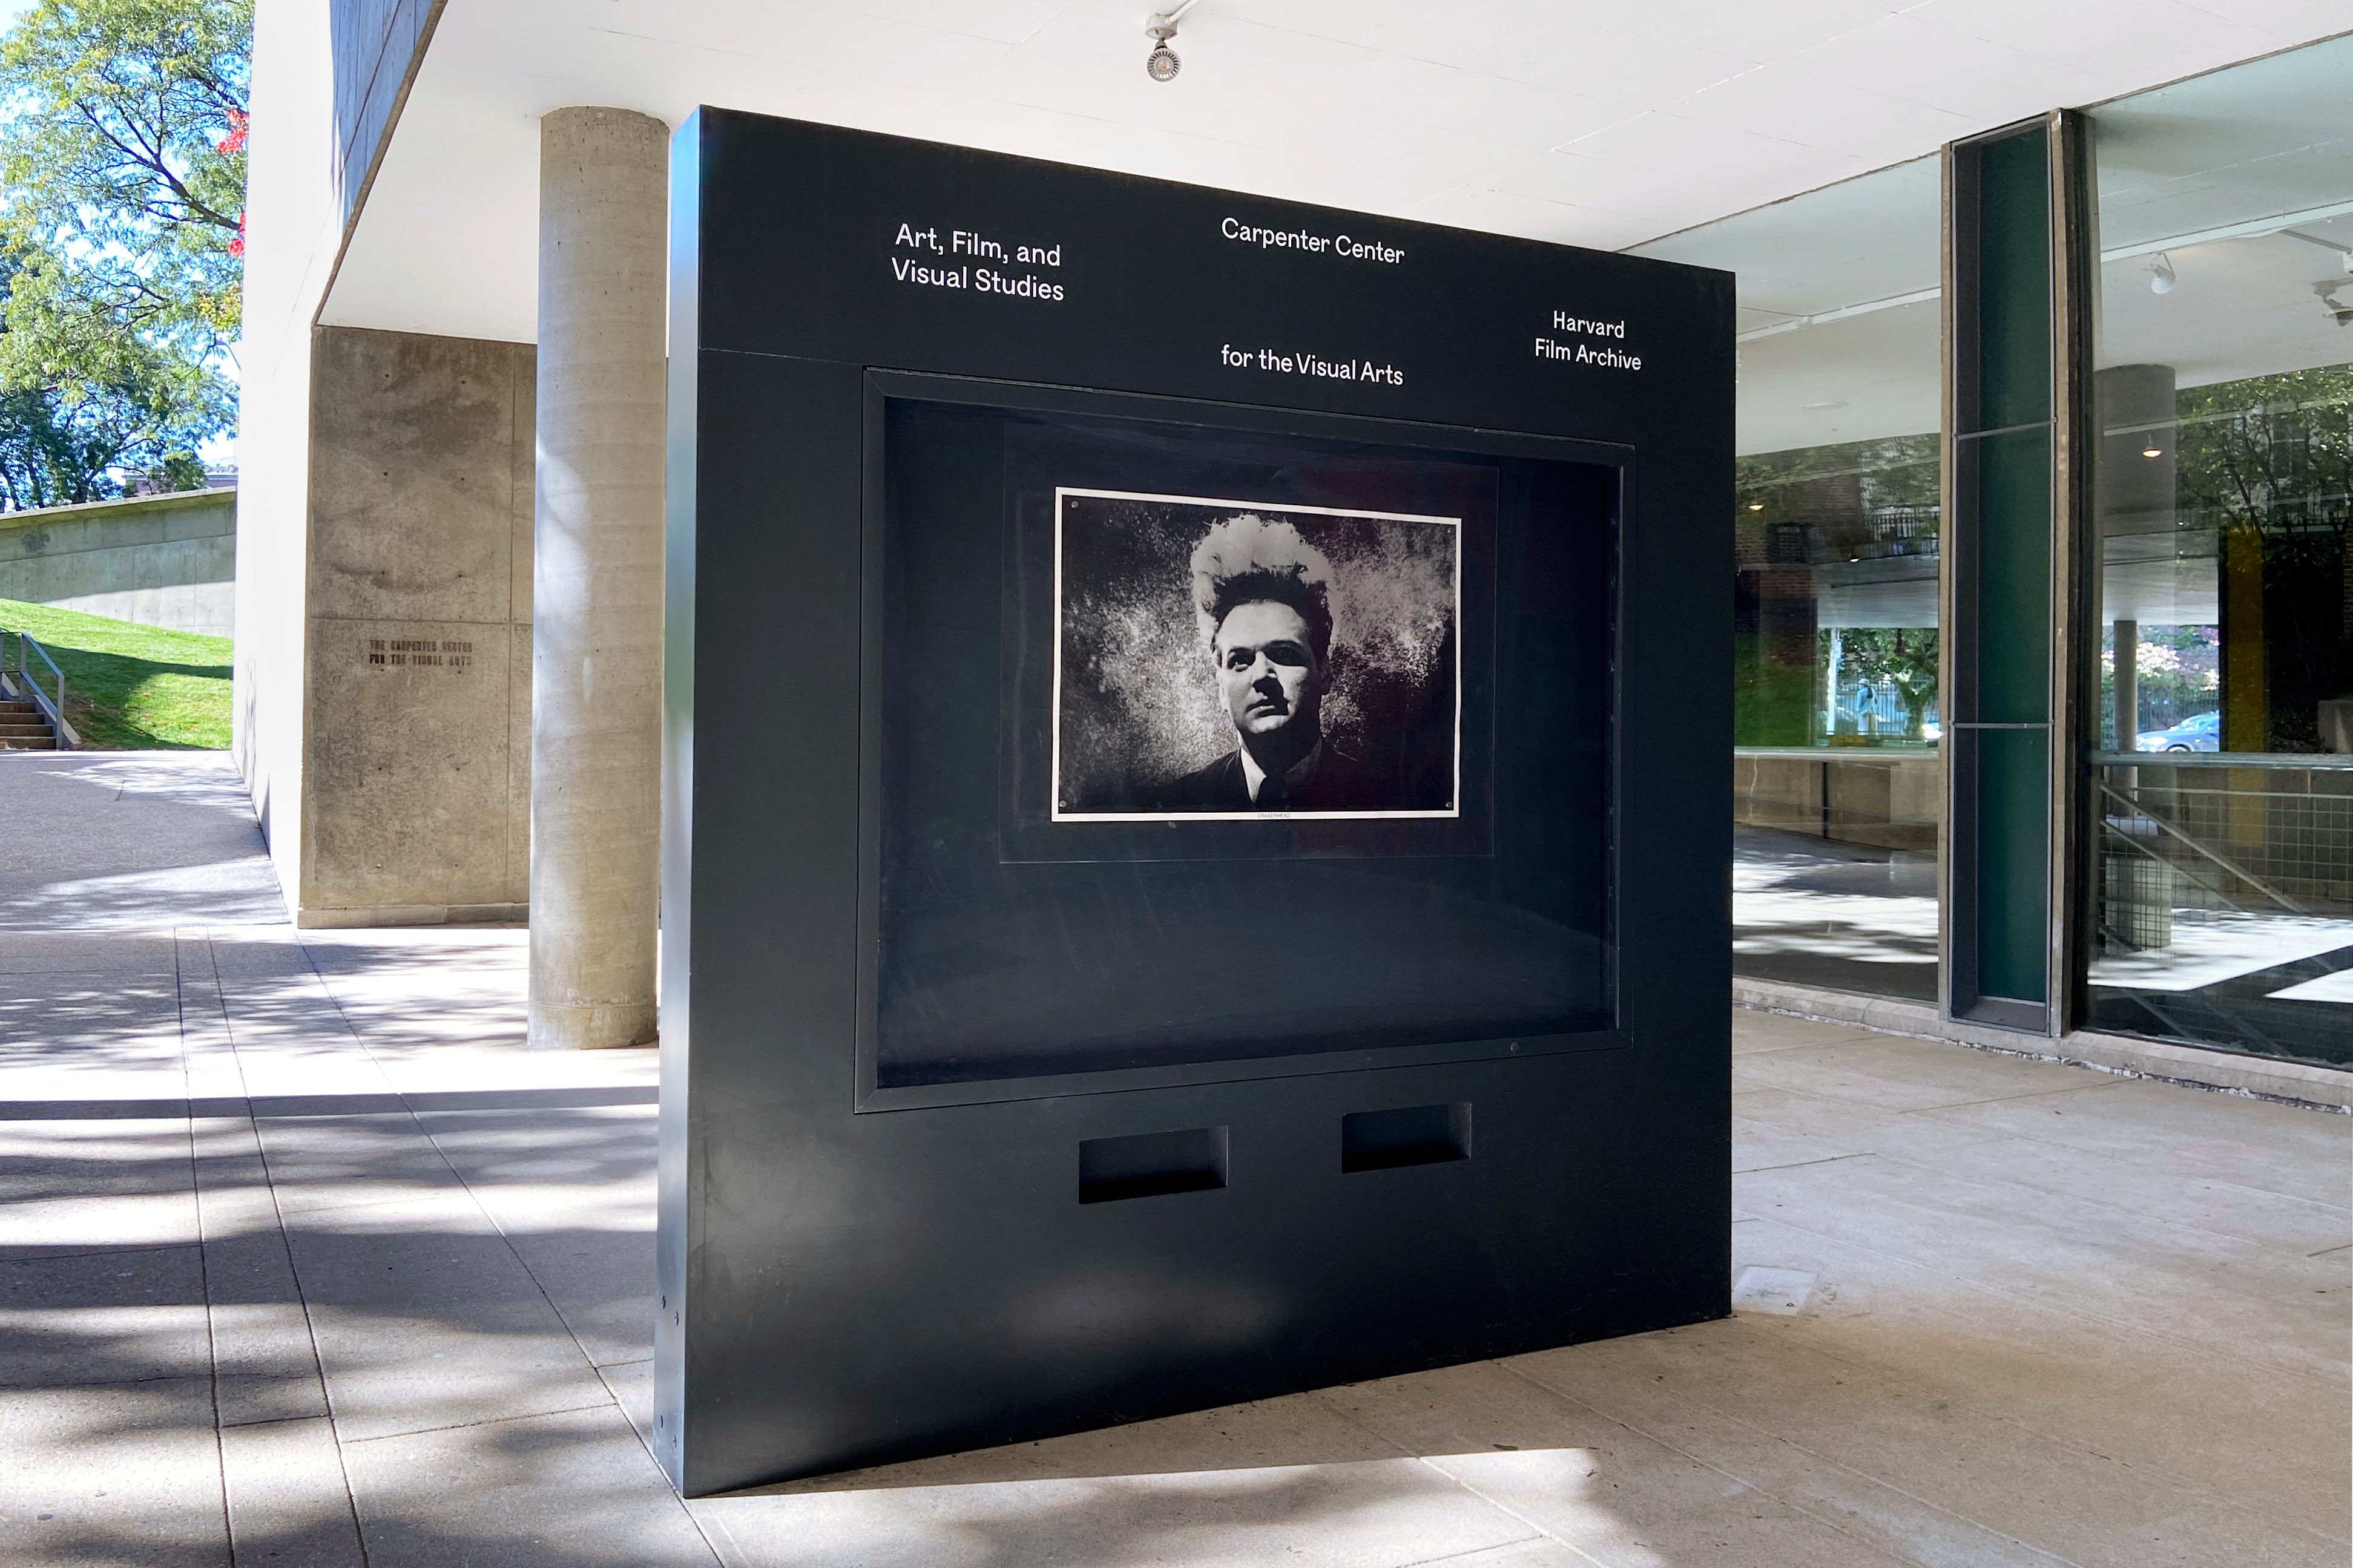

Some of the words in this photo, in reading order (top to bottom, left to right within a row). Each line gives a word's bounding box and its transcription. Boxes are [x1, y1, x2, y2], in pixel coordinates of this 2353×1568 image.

[895, 223, 944, 255] Art,
[953, 230, 1009, 264] Film,
[1016, 244, 1061, 267] and
[1222, 217, 1331, 252] Carpenter
[1335, 235, 1405, 264] Center
[891, 257, 967, 289] Visual
[975, 268, 1064, 301] Studies
[1553, 310, 1624, 339] Harvard
[1221, 344, 1254, 367] for
[1258, 349, 1293, 373] the
[1295, 352, 1356, 380] Visual
[1360, 361, 1403, 385] Arts
[1535, 338, 1571, 361] Film
[1575, 344, 1642, 370] Archive
[370, 654, 385, 664] FOR
[392, 654, 406, 664] THE
[412, 655, 443, 666] VISUAL
